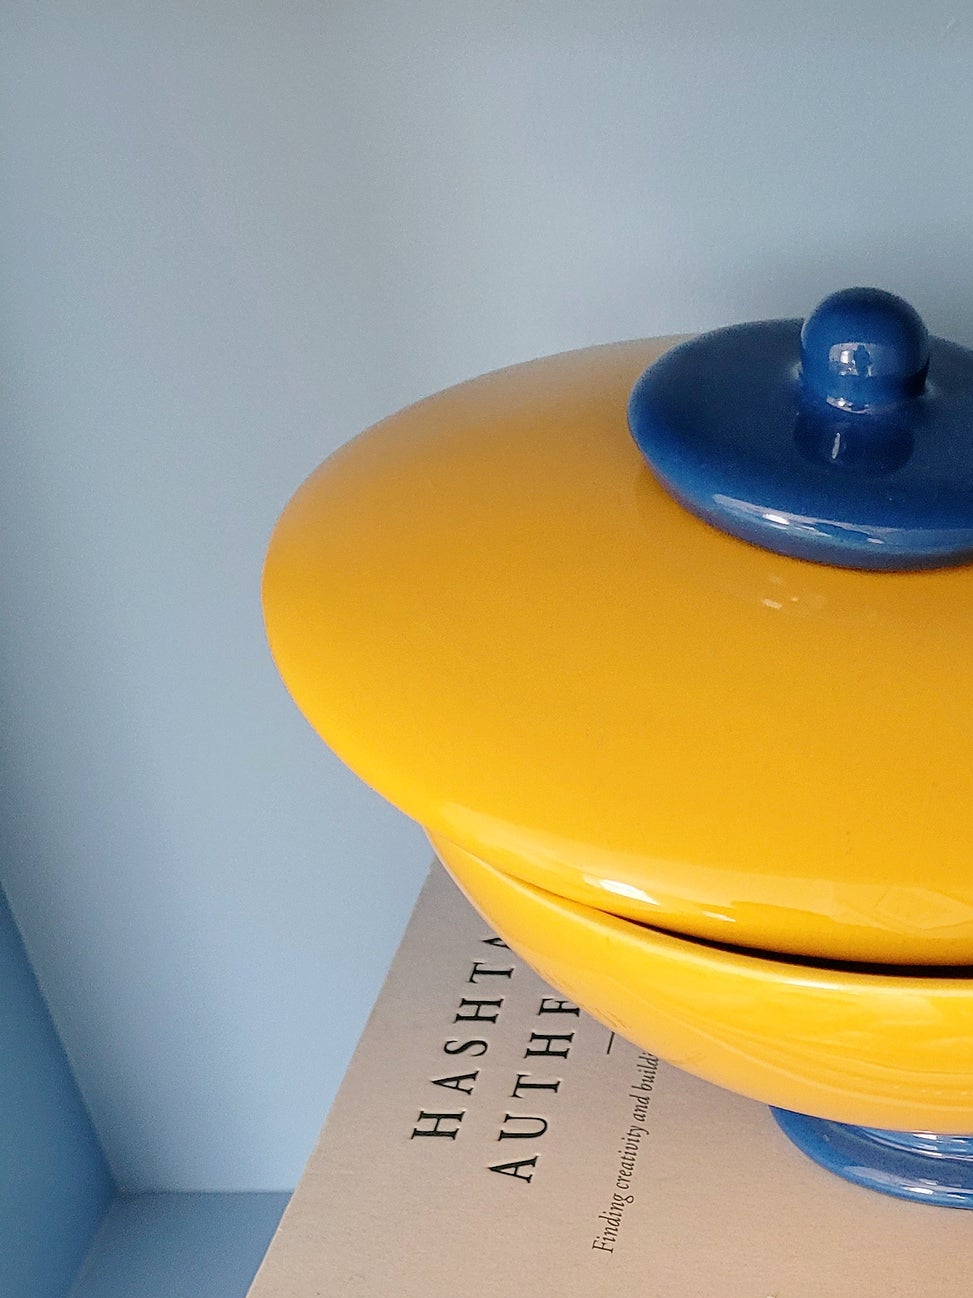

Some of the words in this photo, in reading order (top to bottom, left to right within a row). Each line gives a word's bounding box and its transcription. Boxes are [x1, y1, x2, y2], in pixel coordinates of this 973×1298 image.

[629, 1094, 650, 1122] and
[616, 1125, 650, 1190] creativity
[592, 1193, 634, 1254] Finding
